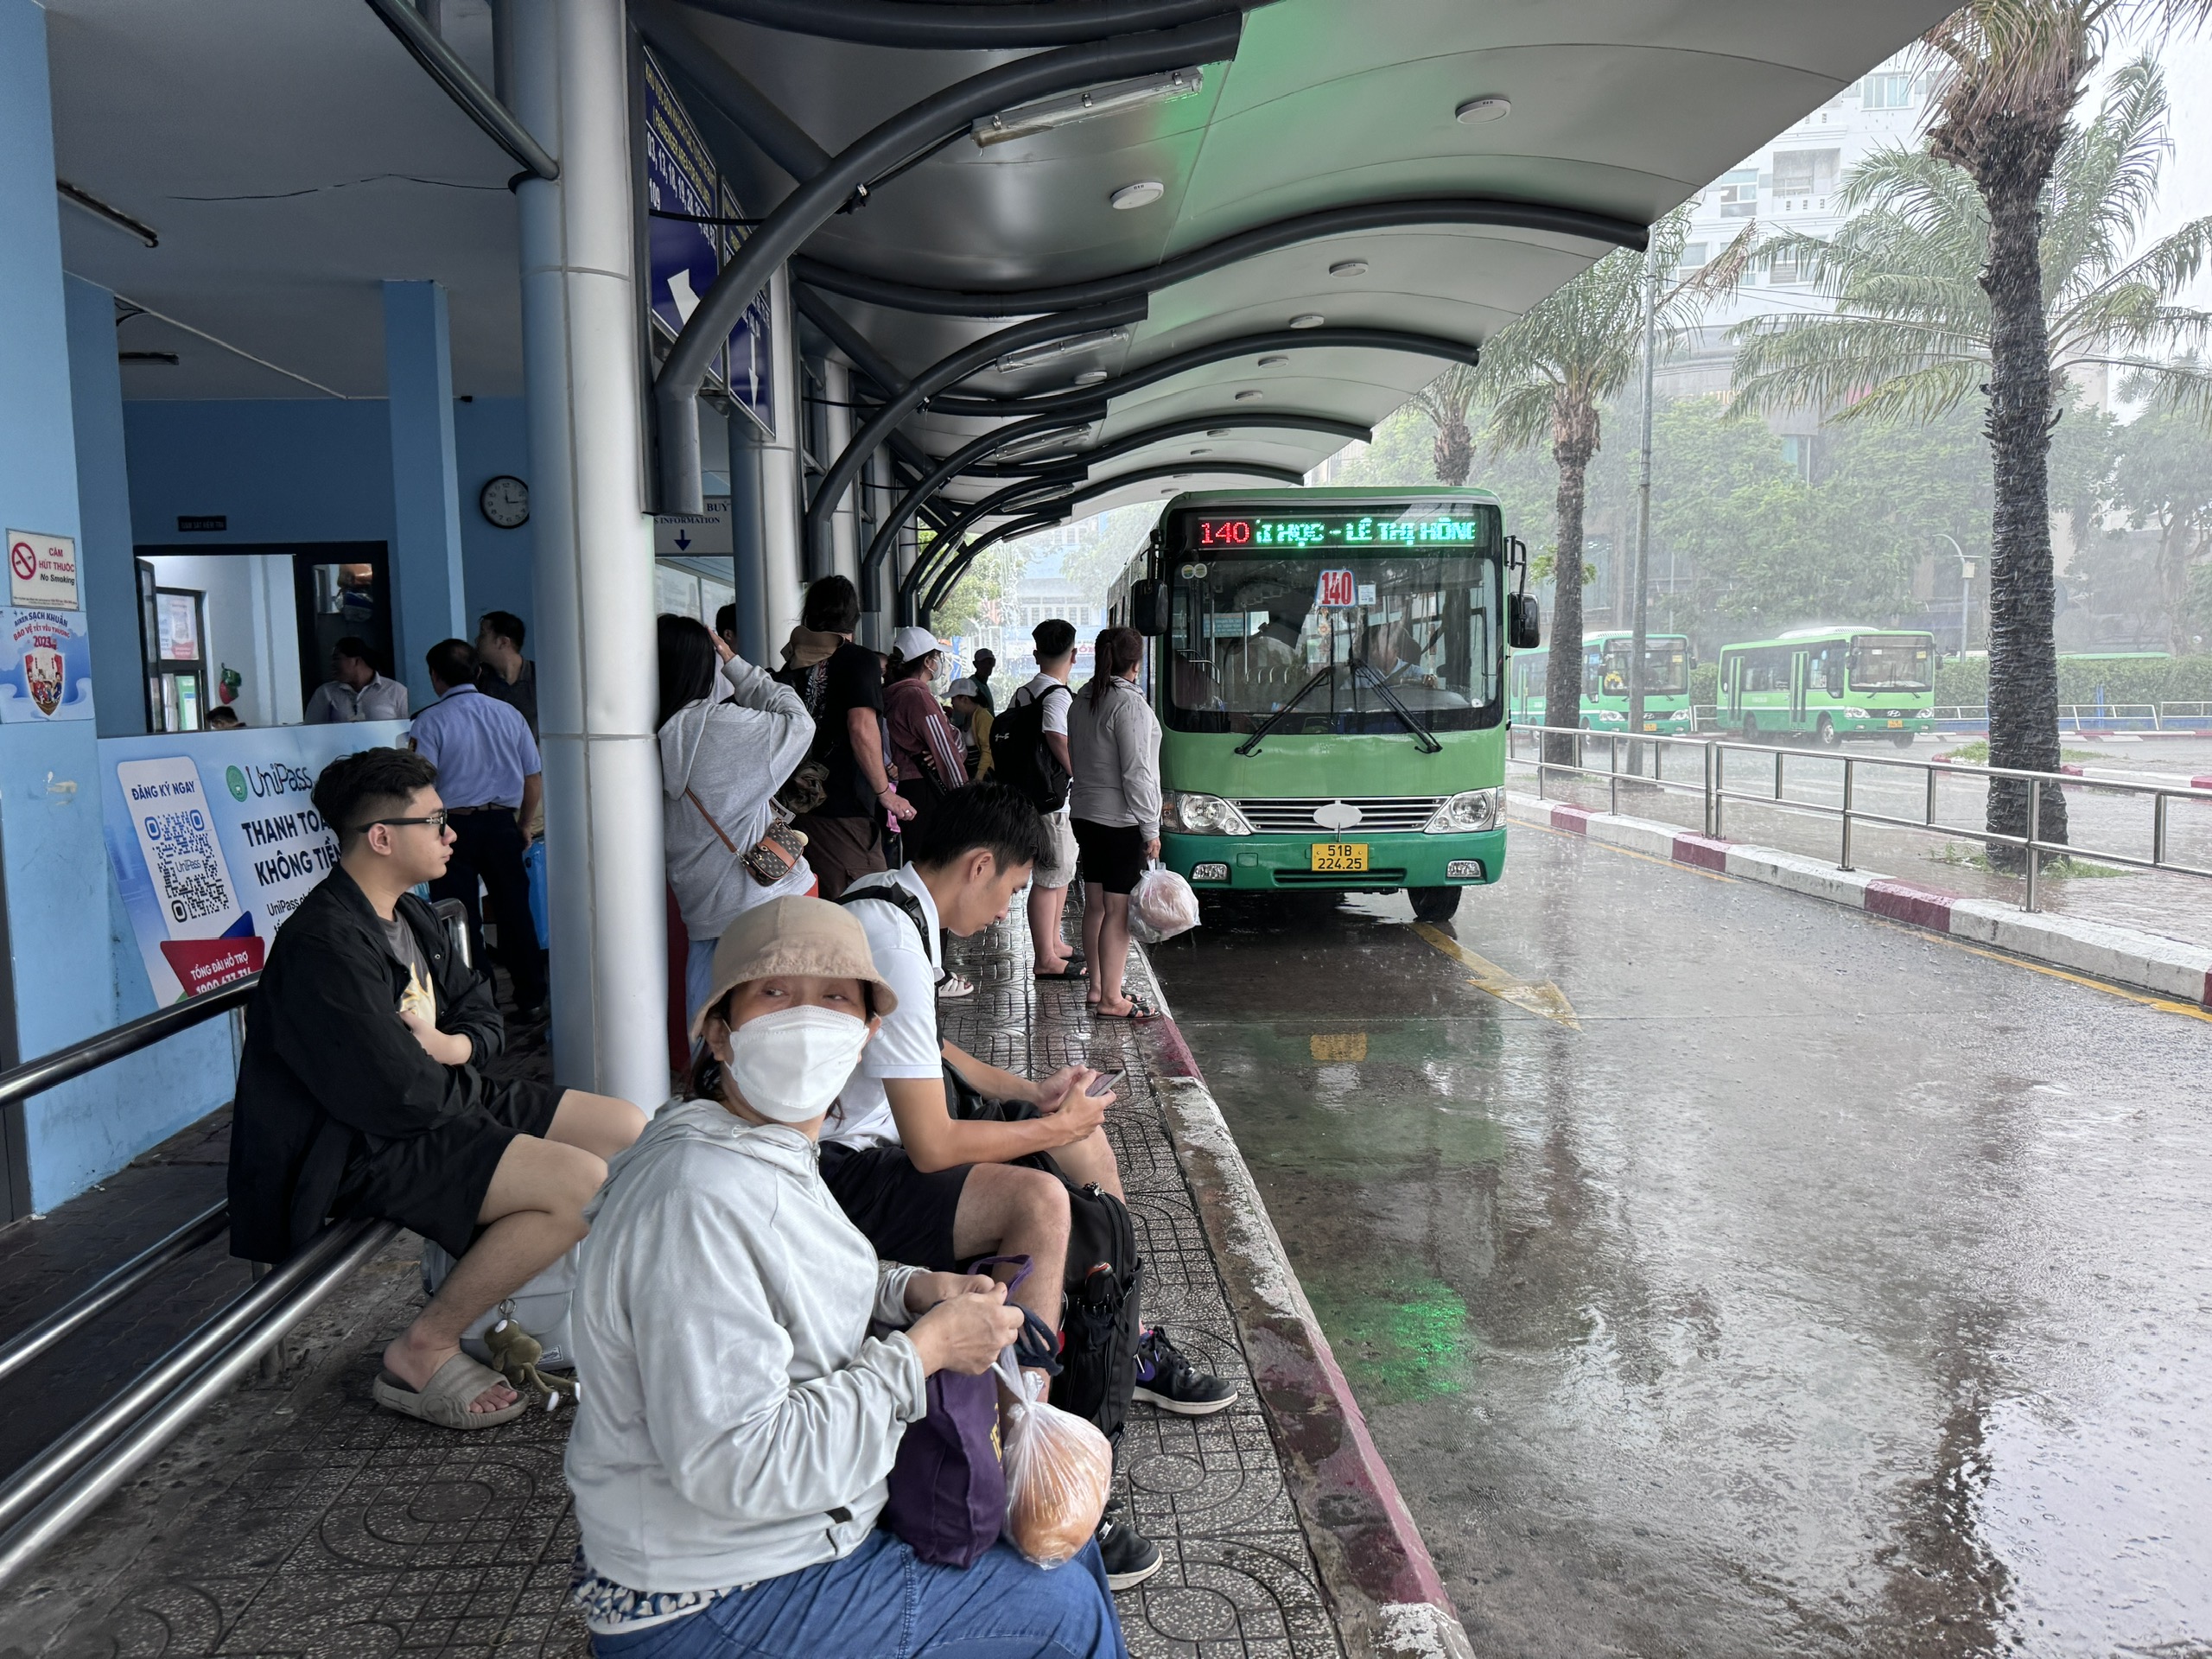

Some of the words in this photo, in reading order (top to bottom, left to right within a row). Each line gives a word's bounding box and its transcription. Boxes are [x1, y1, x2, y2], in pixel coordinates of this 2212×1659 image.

[658, 149, 669, 184] 13,
[649, 177, 661, 211] 109
[707, 500, 731, 512] BUÝ
[1200, 522, 1250, 543] 140
[1277, 523, 1325, 547] HỌC
[1345, 517, 1373, 541] LÊ
[1377, 522, 1415, 545] THỊ
[41, 573, 49, 582] No
[50, 574, 75, 586] Smoking
[1322, 572, 1352, 605] 140
[29, 612, 45, 621] SẠCH
[33, 635, 53, 648] 2023
[245, 762, 313, 798] UniPass
[131, 784, 158, 800] ĐĂNG
[159, 782, 172, 797] KÝ
[172, 781, 195, 794] NGAY
[241, 814, 298, 847] THANH
[1328, 845, 1352, 856] 51B
[175, 859, 201, 873] UniPass
[254, 850, 313, 887] KHÔNG
[1318, 858, 1362, 869] 224.25
[267, 899, 300, 916] UniPass
[190, 963, 212, 980] TỔNG
[211, 958, 225, 973] ĐÀI
[234, 950, 248, 964] TRỢ
